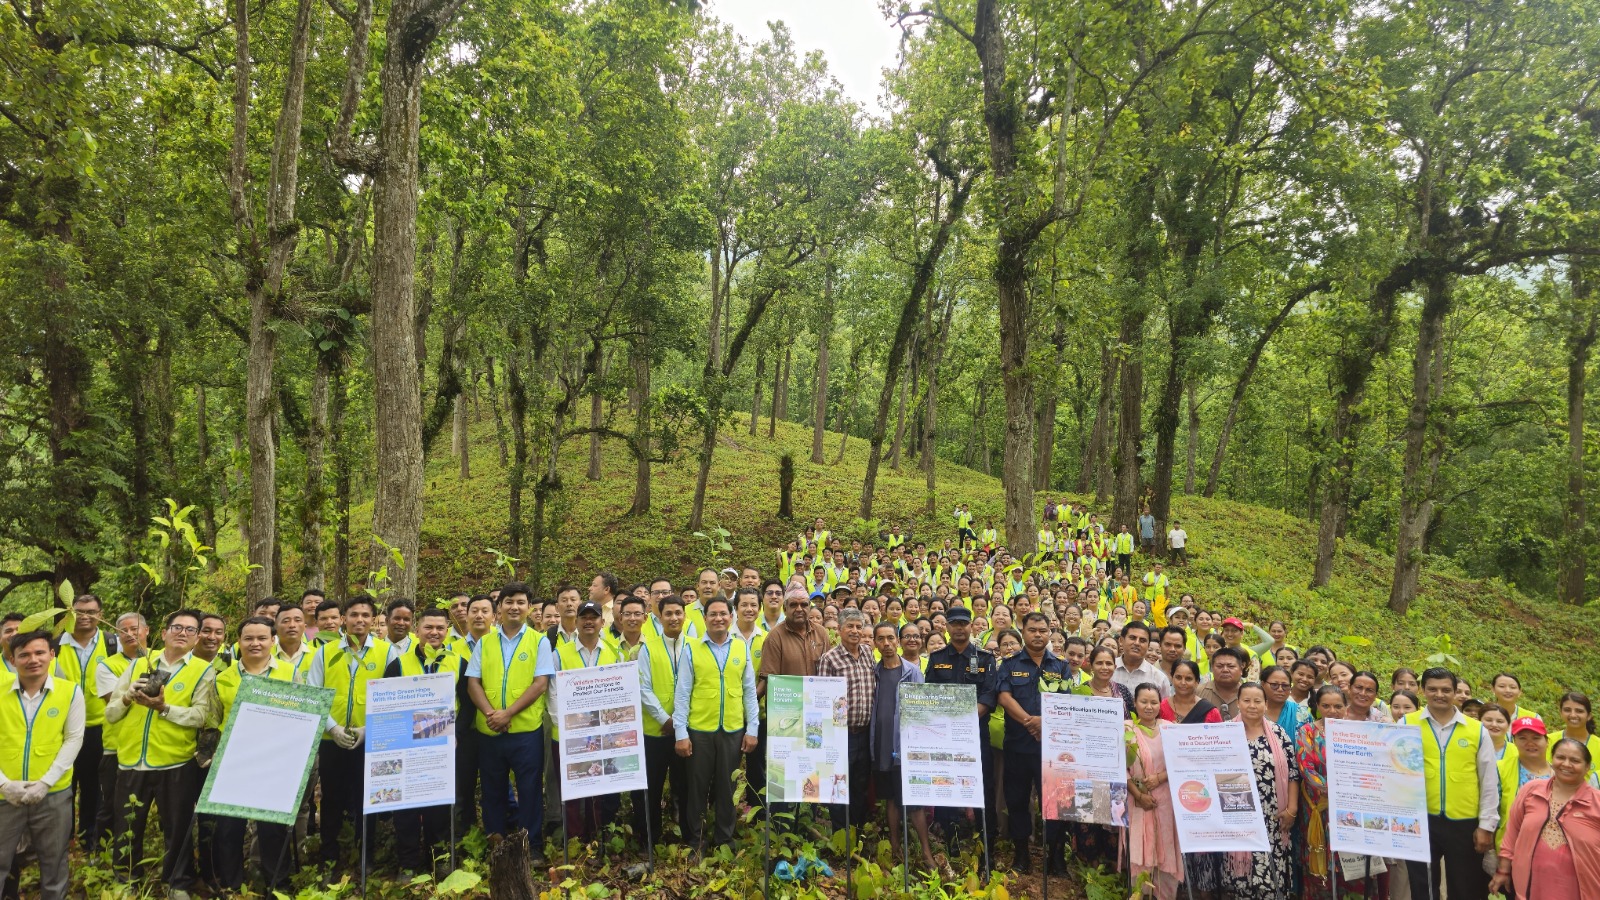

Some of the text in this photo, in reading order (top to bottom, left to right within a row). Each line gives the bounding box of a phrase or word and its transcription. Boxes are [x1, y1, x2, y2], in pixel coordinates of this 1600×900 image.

[594, 675, 623, 683] Prevention
[267, 691, 283, 699] Love
[289, 695, 305, 703] Hear
[305, 697, 321, 705] Your
[904, 693, 939, 701] Disappearing
[1332, 736, 1387, 747] Climate Disasters
[1343, 743, 1368, 751] Restore
[1355, 750, 1374, 758] Earth
